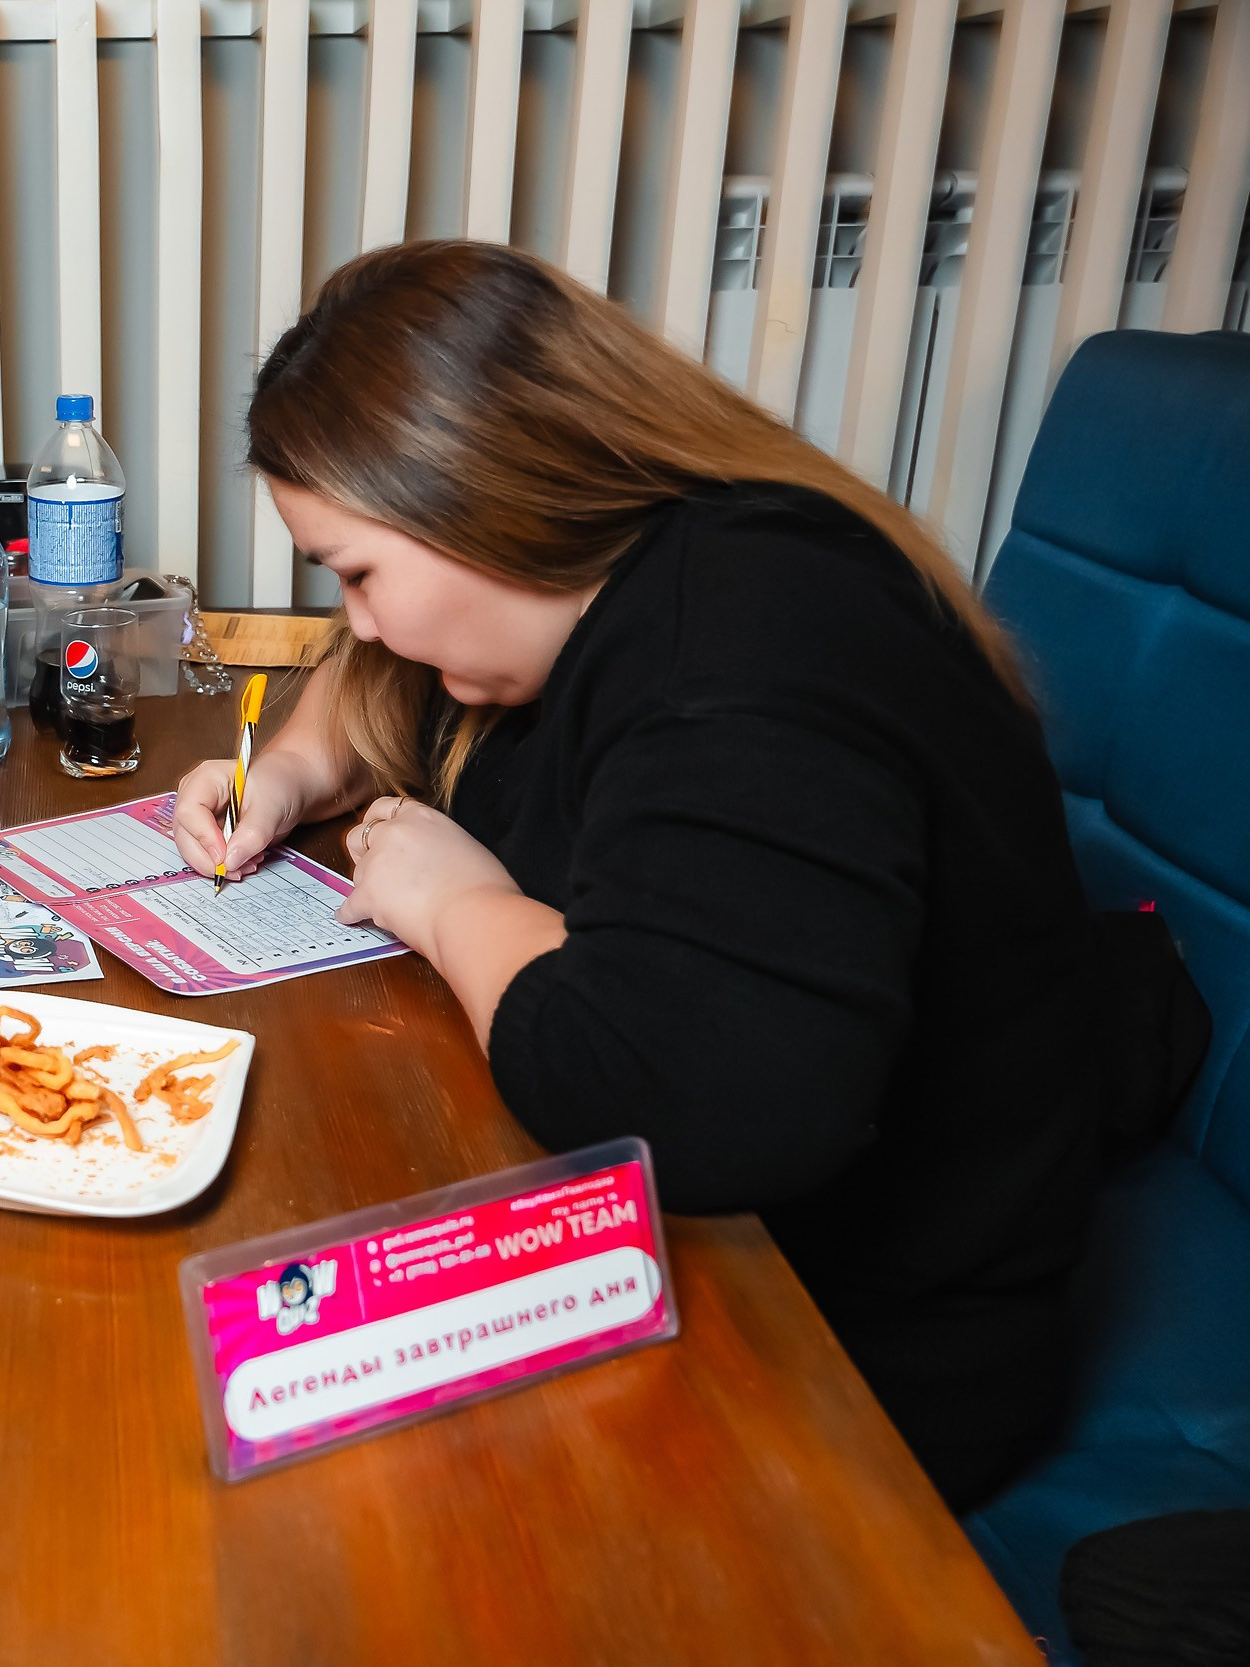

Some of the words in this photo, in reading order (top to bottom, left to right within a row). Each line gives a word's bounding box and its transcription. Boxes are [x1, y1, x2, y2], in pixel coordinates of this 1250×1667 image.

[103, 926, 152, 957] ВЕРСИЯ
[145, 957, 188, 984] ВАША
[572, 1195, 605, 1211] name
[494, 1219, 564, 1261] WOW
[566, 1199, 638, 1239] TEAM
[249, 1355, 383, 1411] Легенды
[394, 1294, 577, 1365] завтрашнего
[588, 1276, 639, 1306] дня
